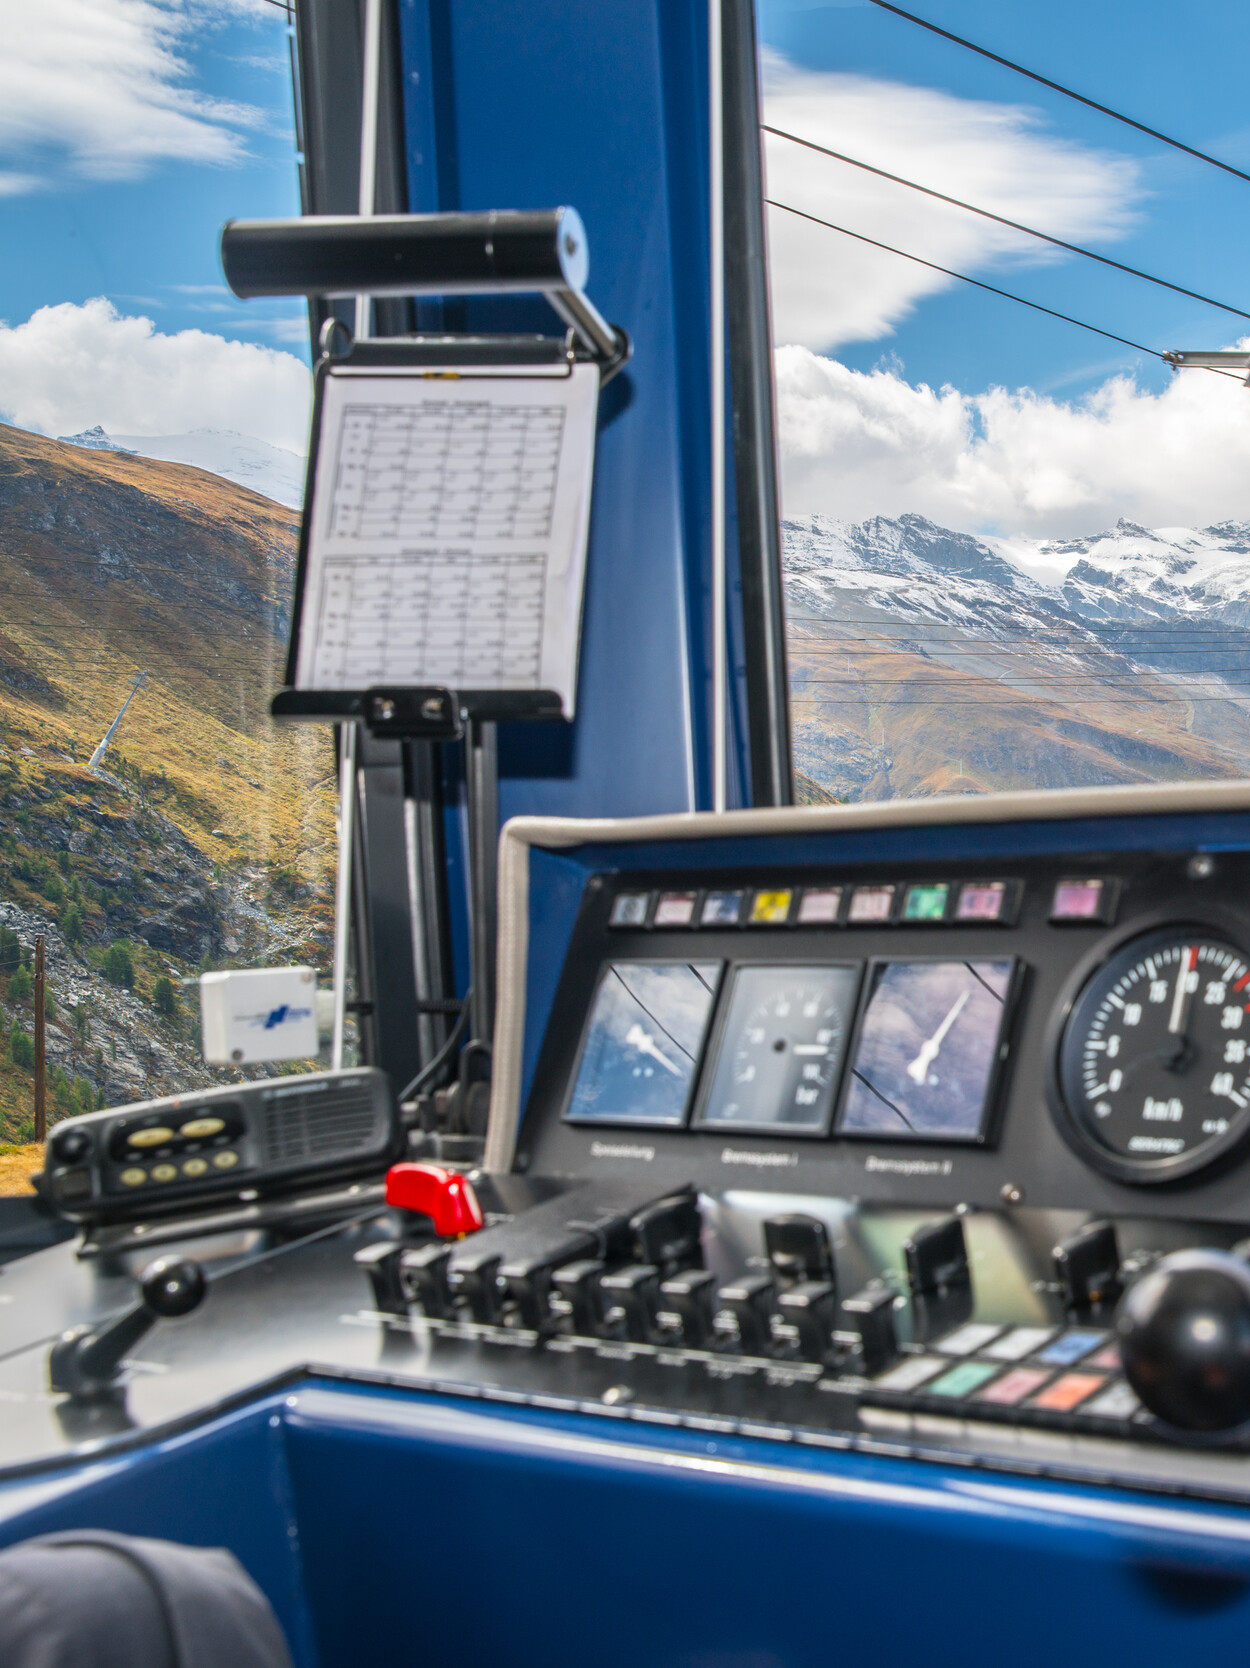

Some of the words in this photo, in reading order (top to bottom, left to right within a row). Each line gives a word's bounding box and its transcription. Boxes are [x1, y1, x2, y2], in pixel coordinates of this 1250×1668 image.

[1149, 980, 1169, 1003] 15
[1204, 981, 1227, 1004] 25
[1123, 1003, 1142, 1026] 10
[1221, 1005, 1244, 1029] 30
[1106, 1035, 1121, 1058] 5
[1224, 1040, 1247, 1063] 35
[1109, 1069, 1123, 1092] 0
[1210, 1072, 1234, 1096] 40
[795, 1084, 819, 1106] bar
[1142, 1096, 1184, 1122] km/h
